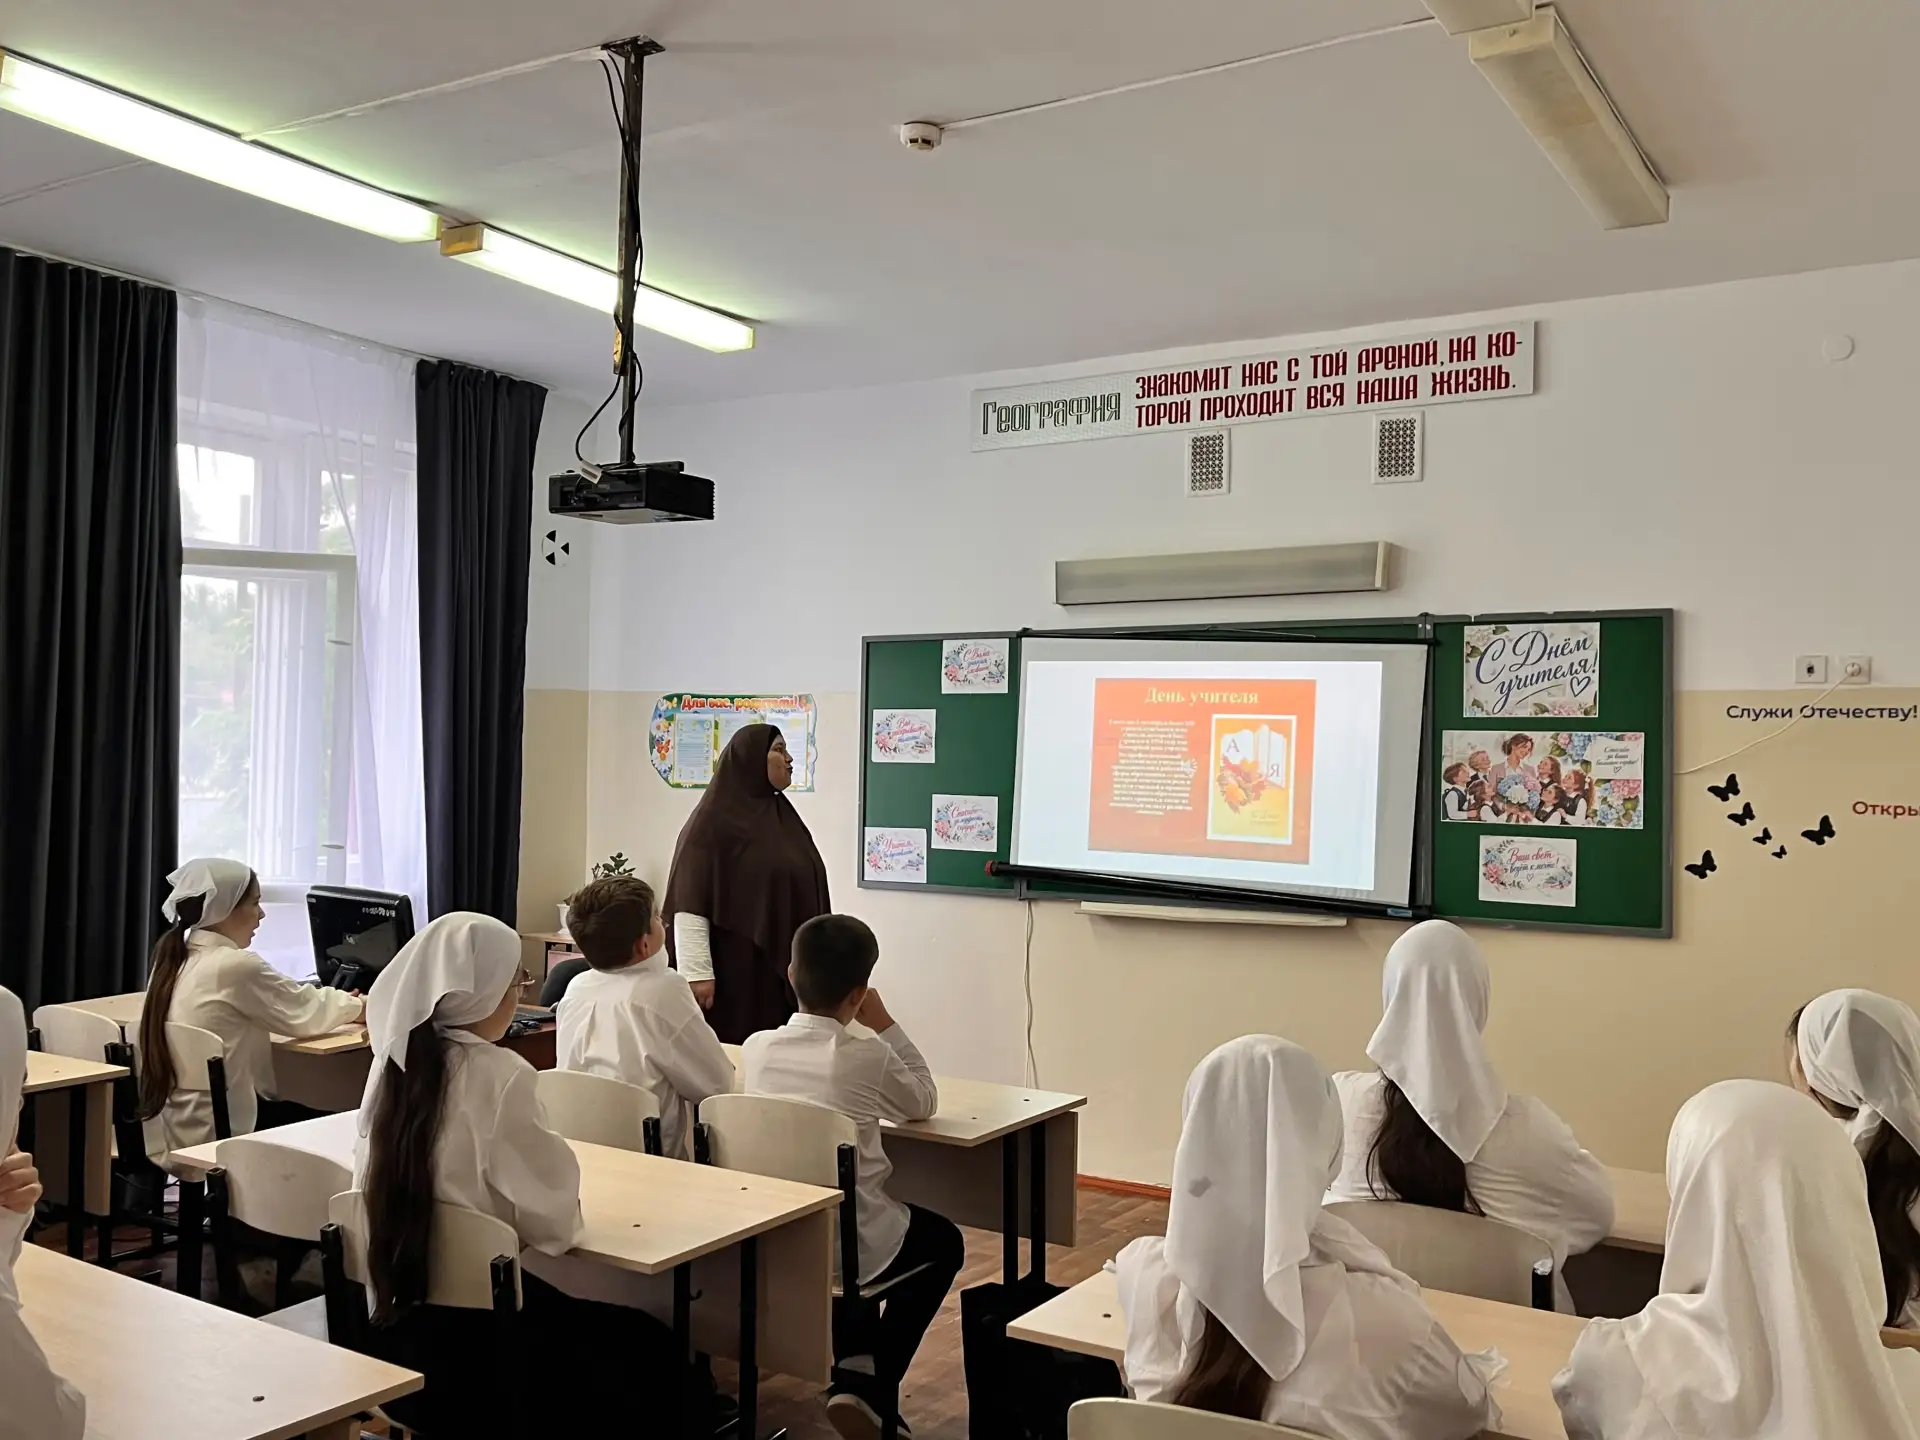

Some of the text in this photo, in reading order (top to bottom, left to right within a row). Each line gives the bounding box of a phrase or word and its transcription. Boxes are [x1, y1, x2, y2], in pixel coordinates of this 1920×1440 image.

[1241, 360, 1278, 387] НАС
[1287, 357, 1299, 382] С
[1310, 349, 1347, 379] ТОЙ
[1448, 335, 1476, 363] НА
[1487, 331, 1523, 358] КО-
[1135, 364, 1517, 428] ТОРОЙ ПРОХОДИТ ВСЯ НАША ЖИЗНЬ.
[982, 392, 1121, 435] География
[1475, 630, 1593, 684] С Днём
[1144, 685, 1258, 707] День учителя
[1492, 649, 1598, 715] учителя!
[681, 695, 706, 711] Для
[1726, 705, 1918, 722] Служи Отечеству!
[1226, 738, 1240, 753] А
[1269, 763, 1280, 777] Я
